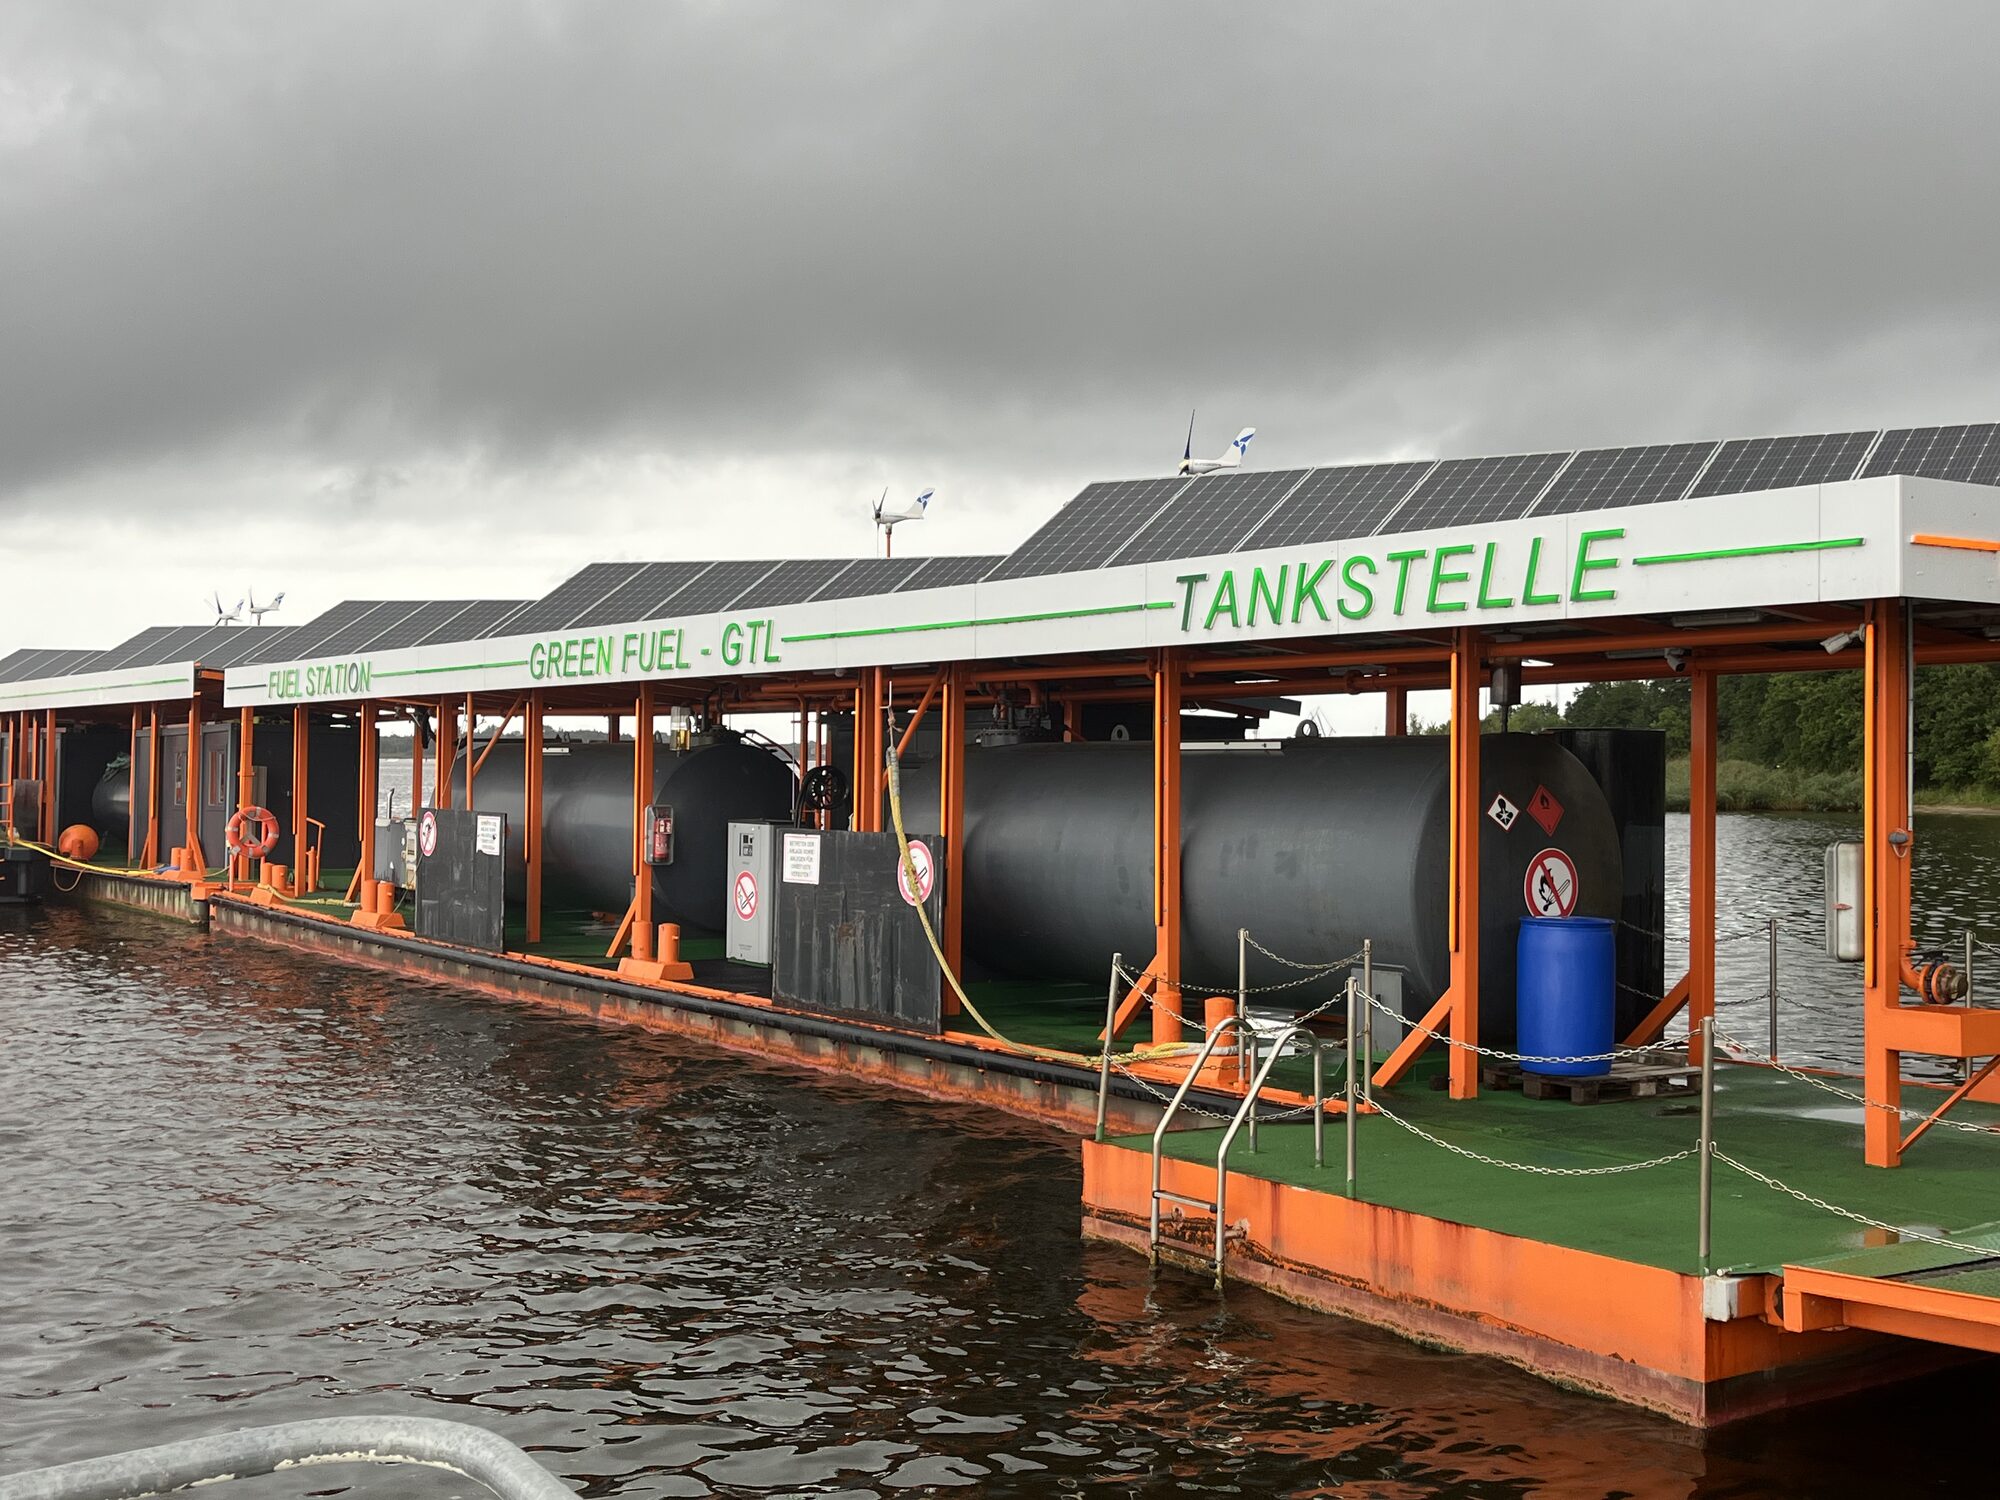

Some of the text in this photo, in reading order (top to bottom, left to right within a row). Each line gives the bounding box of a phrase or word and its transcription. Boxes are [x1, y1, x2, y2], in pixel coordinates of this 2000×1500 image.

[1177, 528, 1627, 632] TANKSTELLE
[268, 661, 372, 699] FUEL STATION
[530, 635, 615, 680] GREEN
[622, 628, 692, 674] FUEL
[722, 619, 782, 666] GTL
